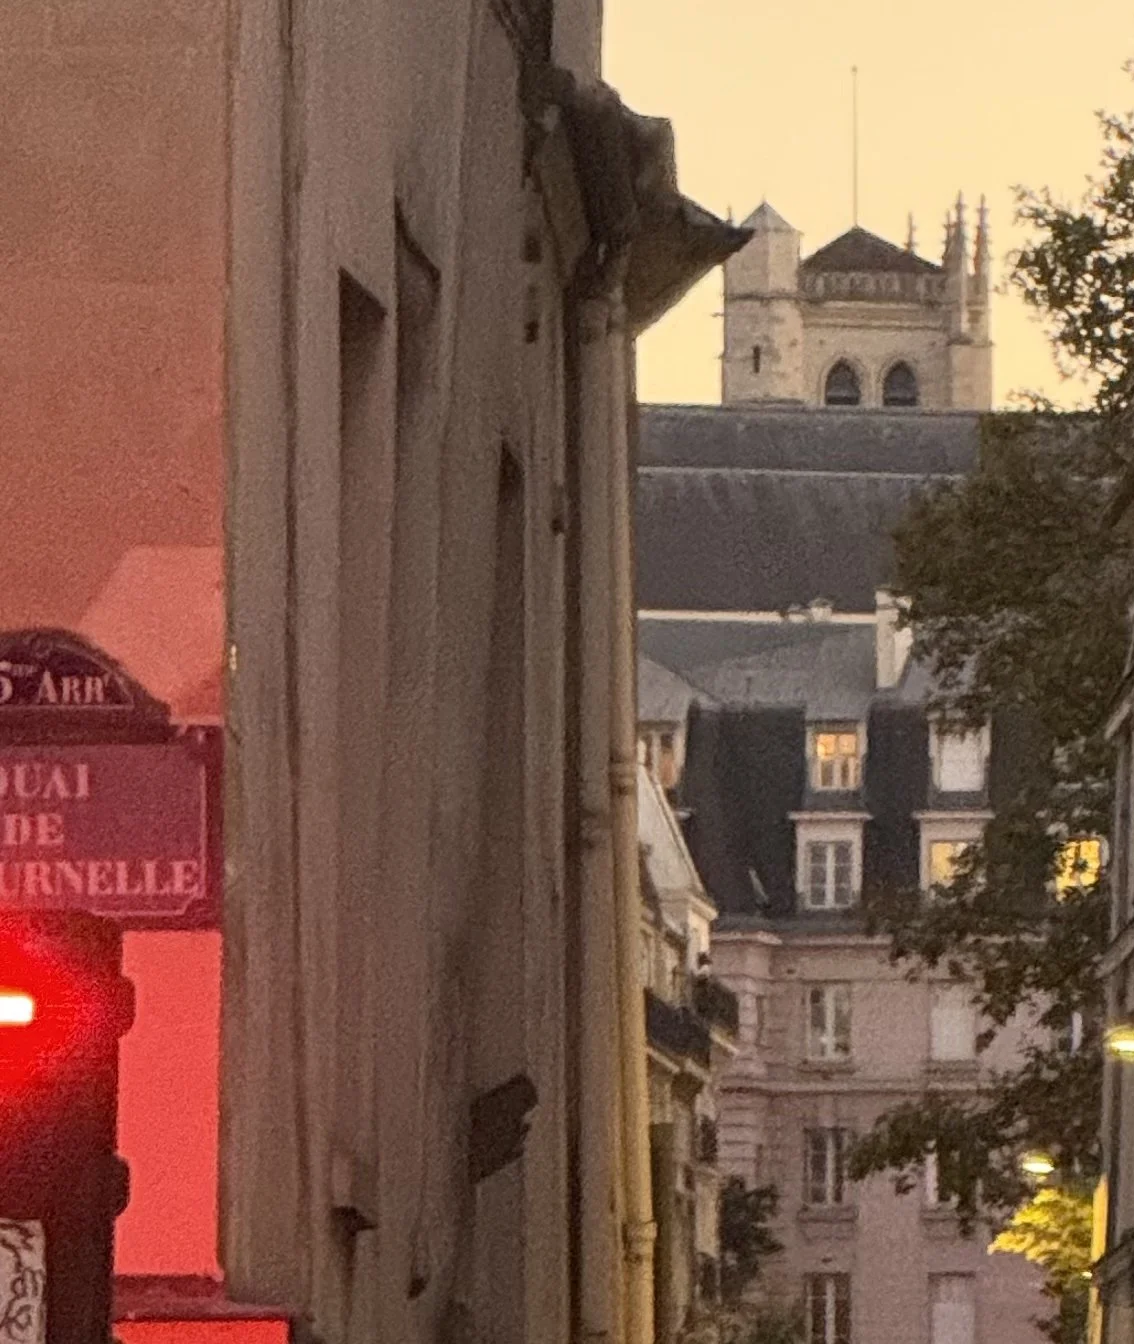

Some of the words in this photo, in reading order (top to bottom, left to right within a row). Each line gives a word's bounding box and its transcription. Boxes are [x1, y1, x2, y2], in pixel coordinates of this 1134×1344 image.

[0, 763, 90, 799] UAI
[3, 813, 65, 846] DE
[0, 860, 200, 896] URNELLE
